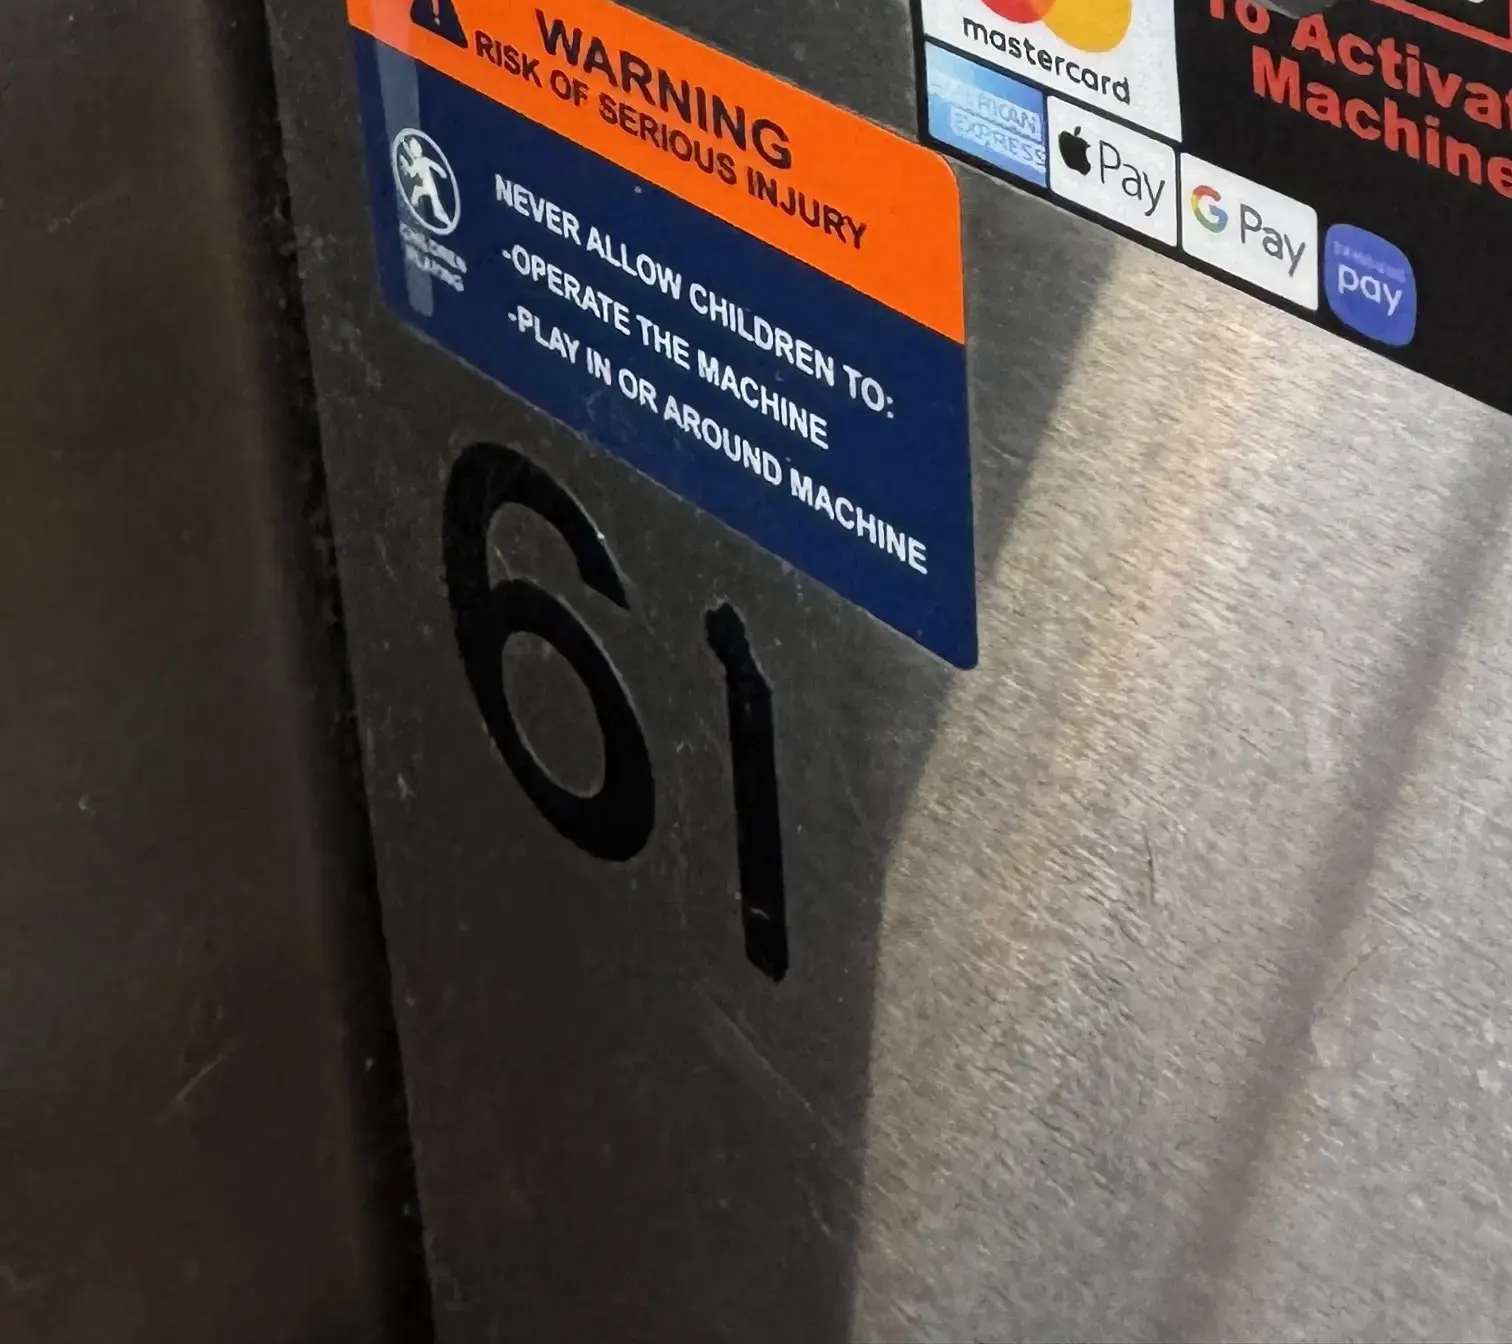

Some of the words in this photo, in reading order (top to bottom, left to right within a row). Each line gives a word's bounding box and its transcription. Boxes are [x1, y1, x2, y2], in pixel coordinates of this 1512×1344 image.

[476, 29, 543, 90] RISK
[550, 70, 588, 107] OF
[598, 90, 737, 186] SERIOUS
[747, 164, 868, 250] INJURY
[534, 9, 794, 170] WARNING
[953, 112, 1046, 166] EXPRESS
[962, 16, 1131, 106] mastercard
[1099, 139, 1166, 217] Pay
[1190, 184, 1229, 234] G
[1240, 202, 1306, 278] Pay
[495, 173, 581, 246] NEVER
[586, 226, 683, 301] ALLOW
[689, 282, 835, 387] CHILDREN
[842, 364, 895, 418] TO:
[502, 244, 631, 336] -OPERATE
[636, 314, 691, 371] THE
[697, 349, 830, 450] MACHINE
[1337, 262, 1404, 317] pay
[508, 305, 580, 367] -PLAY
[586, 346, 612, 386] IN
[618, 367, 659, 414] OR
[664, 395, 783, 486] AROUND
[789, 466, 929, 576] MACHINE
[441, 440, 790, 984] 61
